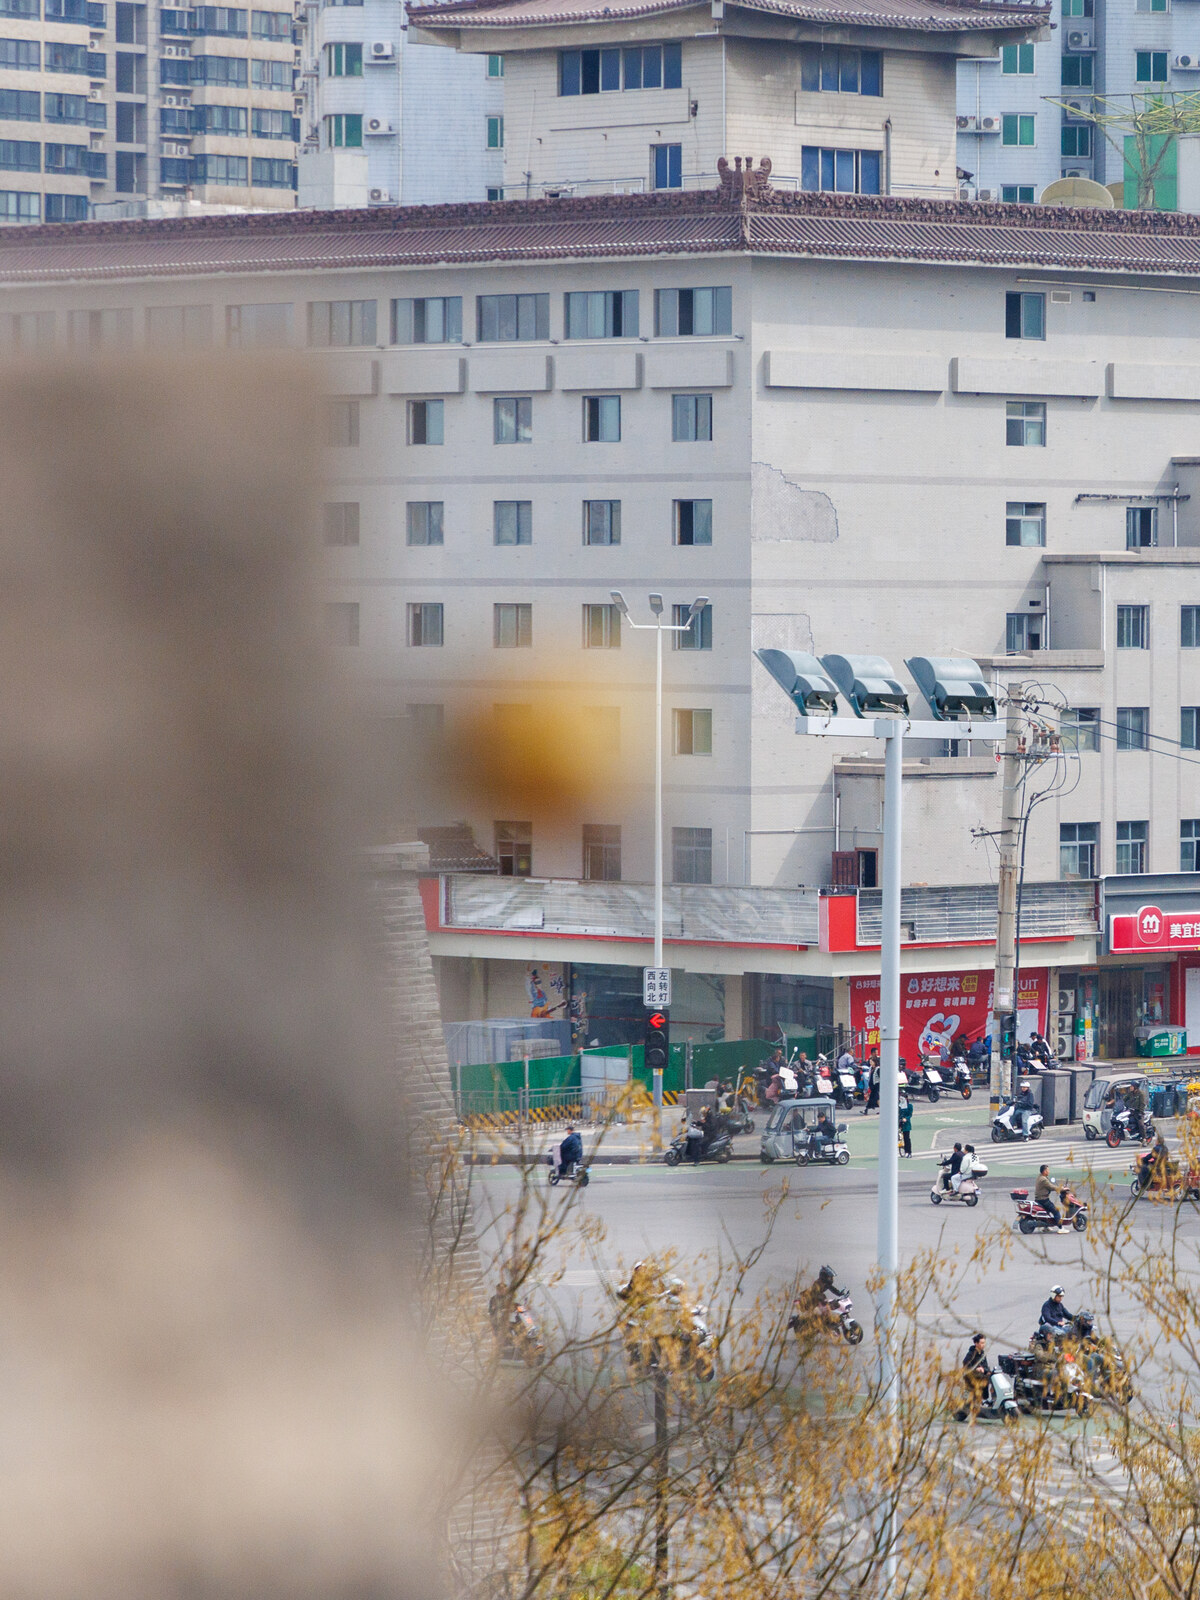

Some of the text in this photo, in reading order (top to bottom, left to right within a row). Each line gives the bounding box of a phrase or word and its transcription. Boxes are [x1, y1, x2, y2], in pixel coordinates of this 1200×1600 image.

[647, 970, 656, 1002] 西向北
[658, 971, 668, 1002] 左转灯
[921, 976, 960, 993] 好想来
